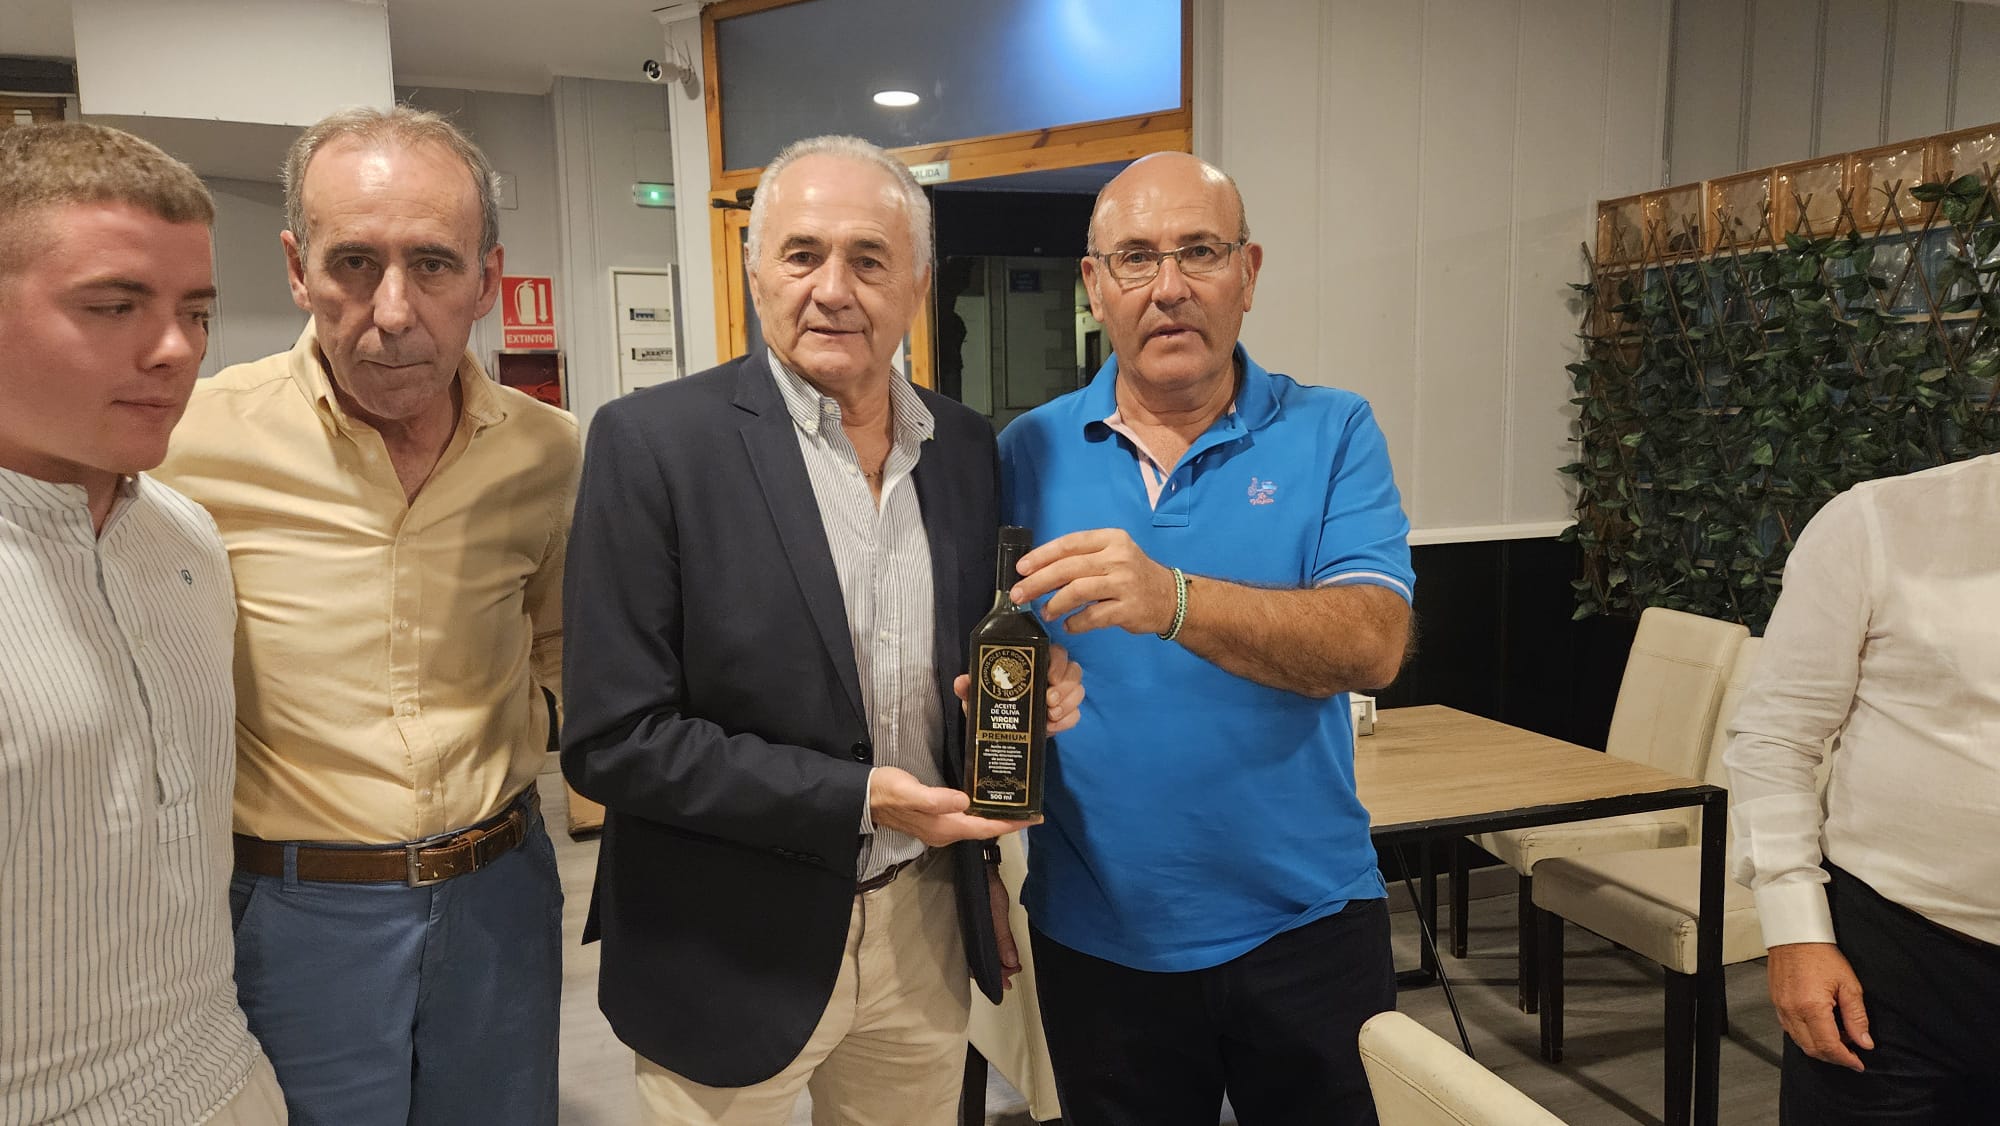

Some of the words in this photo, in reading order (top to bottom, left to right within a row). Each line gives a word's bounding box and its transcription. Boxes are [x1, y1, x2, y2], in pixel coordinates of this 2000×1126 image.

[912, 168, 940, 179] ALIDA
[506, 334, 553, 344] EXTINTOR
[992, 685, 1002, 696] 13
[990, 715, 1019, 723] VIRGEN
[992, 722, 1017, 730] EXTRA
[982, 732, 1027, 741] PREMIUM
